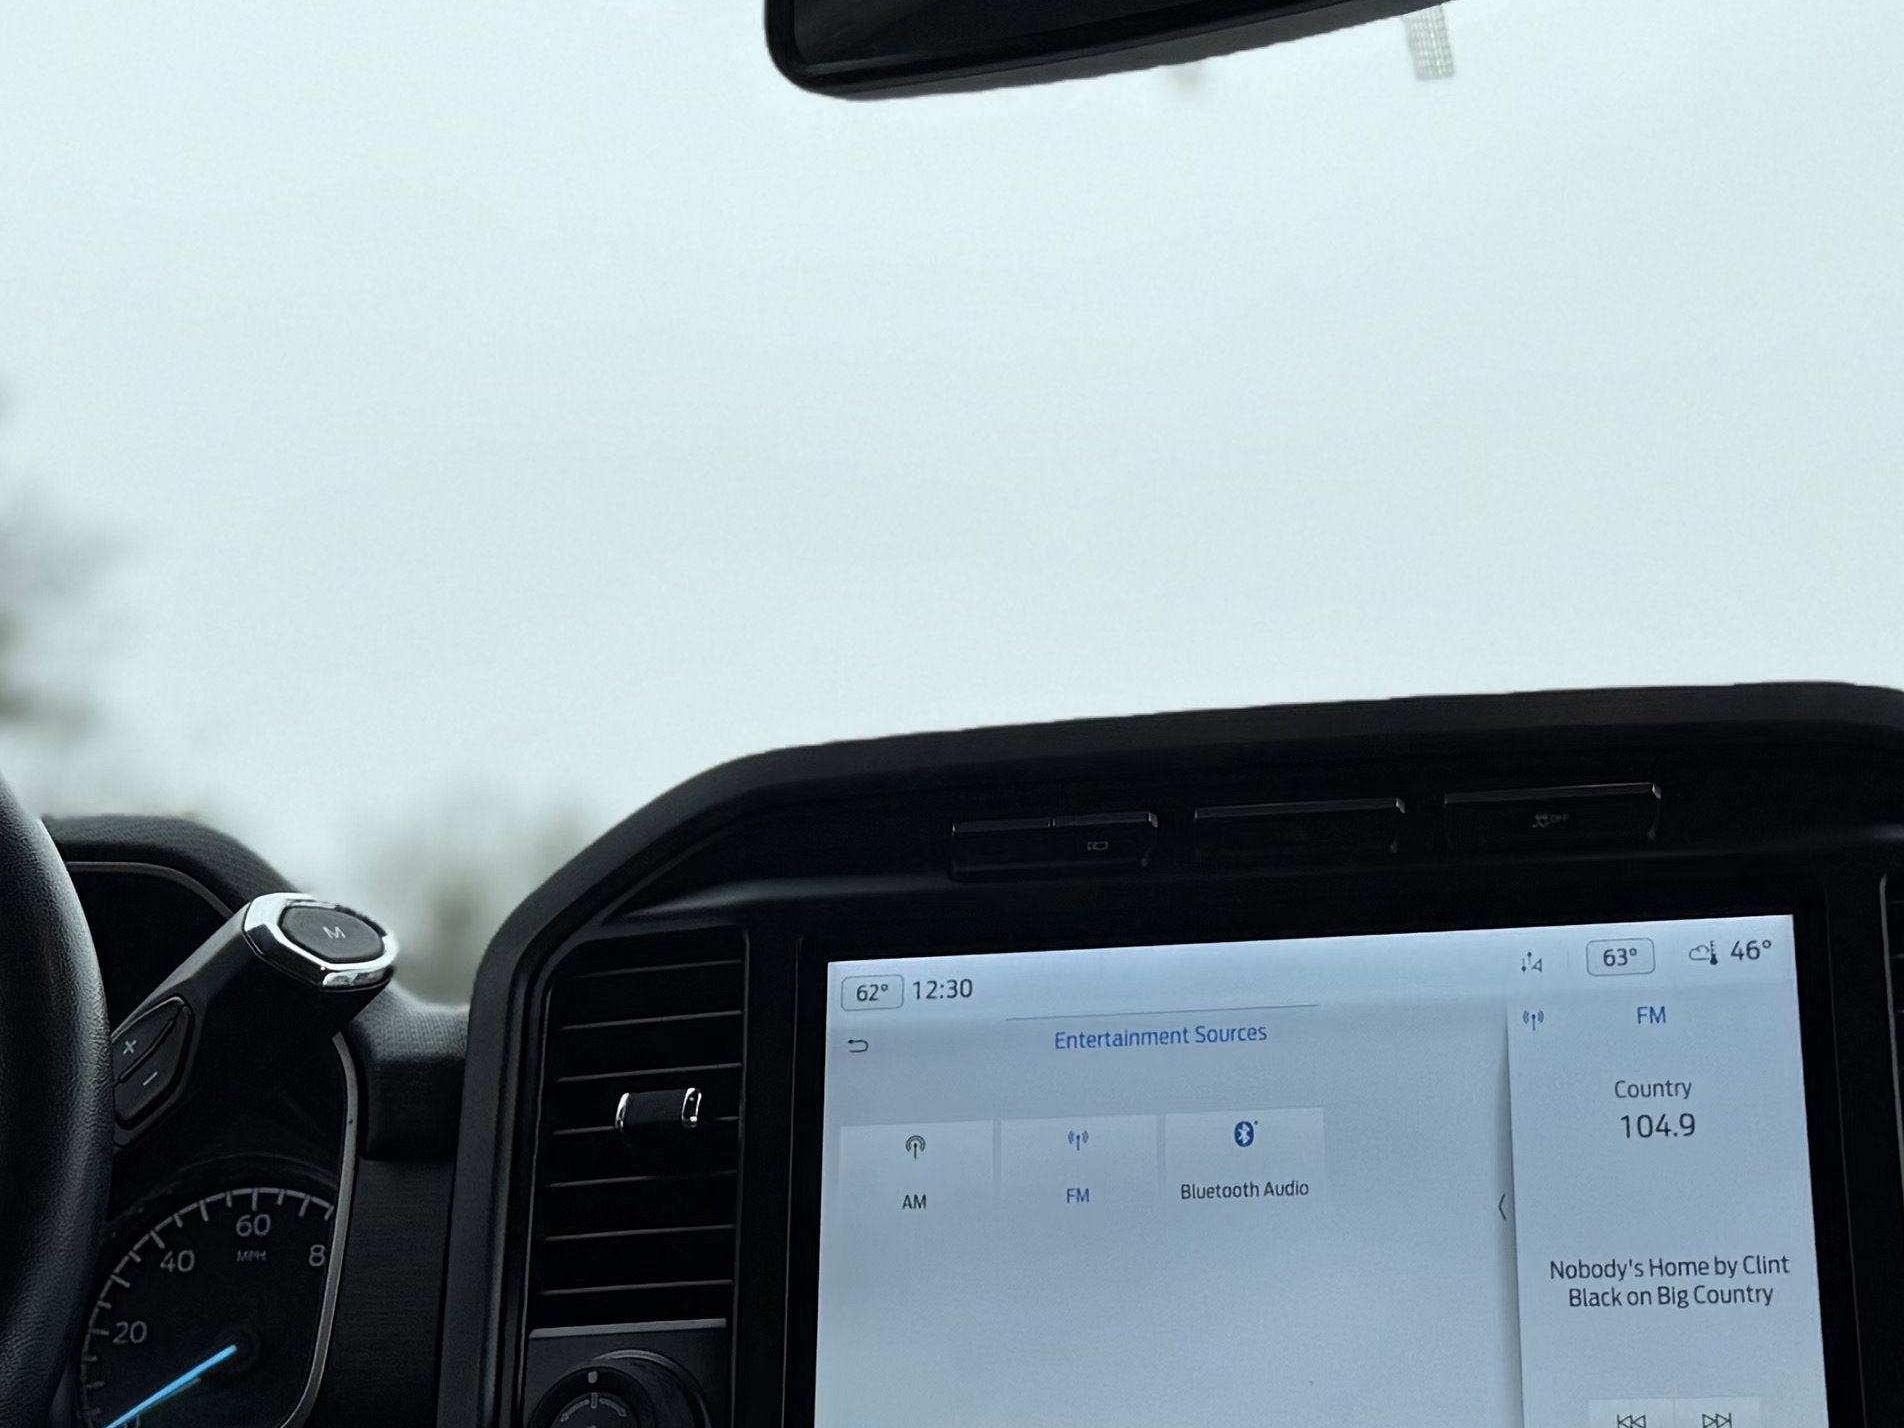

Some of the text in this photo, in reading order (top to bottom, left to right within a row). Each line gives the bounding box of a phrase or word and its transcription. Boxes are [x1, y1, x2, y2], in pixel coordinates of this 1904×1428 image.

[322, 925, 346, 939] M
[912, 978, 974, 1001] 12:30
[1636, 1006, 1667, 1025] FM
[1054, 1025, 1268, 1051] Entertainment Sources
[1613, 1079, 1692, 1100] Country
[1619, 1112, 1696, 1139] 104.9
[1065, 1187, 1091, 1204] FM
[1179, 1179, 1310, 1201] Bluetooth Audio
[900, 1193, 927, 1211] AM
[234, 1213, 272, 1237] 60
[159, 1249, 196, 1273] 40
[235, 1249, 267, 1263] MPH
[1549, 1254, 1790, 1281] Nobody's Home by Clint
[1568, 1284, 1773, 1308] Black on Big Country
[111, 1321, 148, 1345] 20
